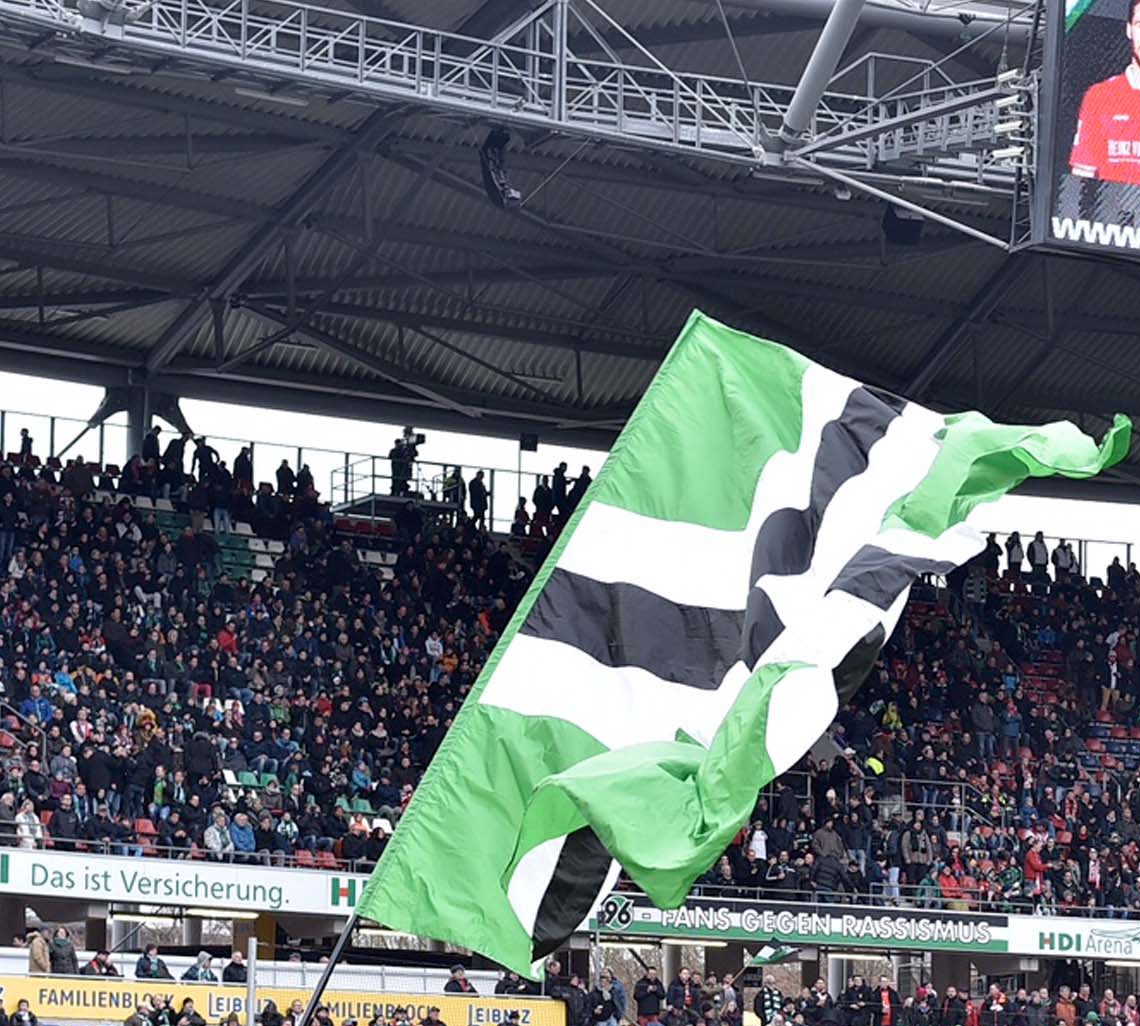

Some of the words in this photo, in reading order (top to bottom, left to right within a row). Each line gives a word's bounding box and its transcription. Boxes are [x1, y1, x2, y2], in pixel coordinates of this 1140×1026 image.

[31, 863, 75, 889] Das
[84, 866, 112, 892] ist
[120, 870, 289, 909] Versicherung.
[603, 898, 633, 927] 96
[662, 905, 731, 931] FANS
[741, 909, 833, 936] GEGEN
[841, 914, 991, 944] RASSISMUS
[1039, 932, 1081, 951] HDI
[1084, 935, 1133, 955] Arena
[38, 988, 174, 1010] FAMILIENBLOK
[208, 992, 273, 1017] LEIBIZ
[468, 1004, 531, 1026] LEIBNZ
